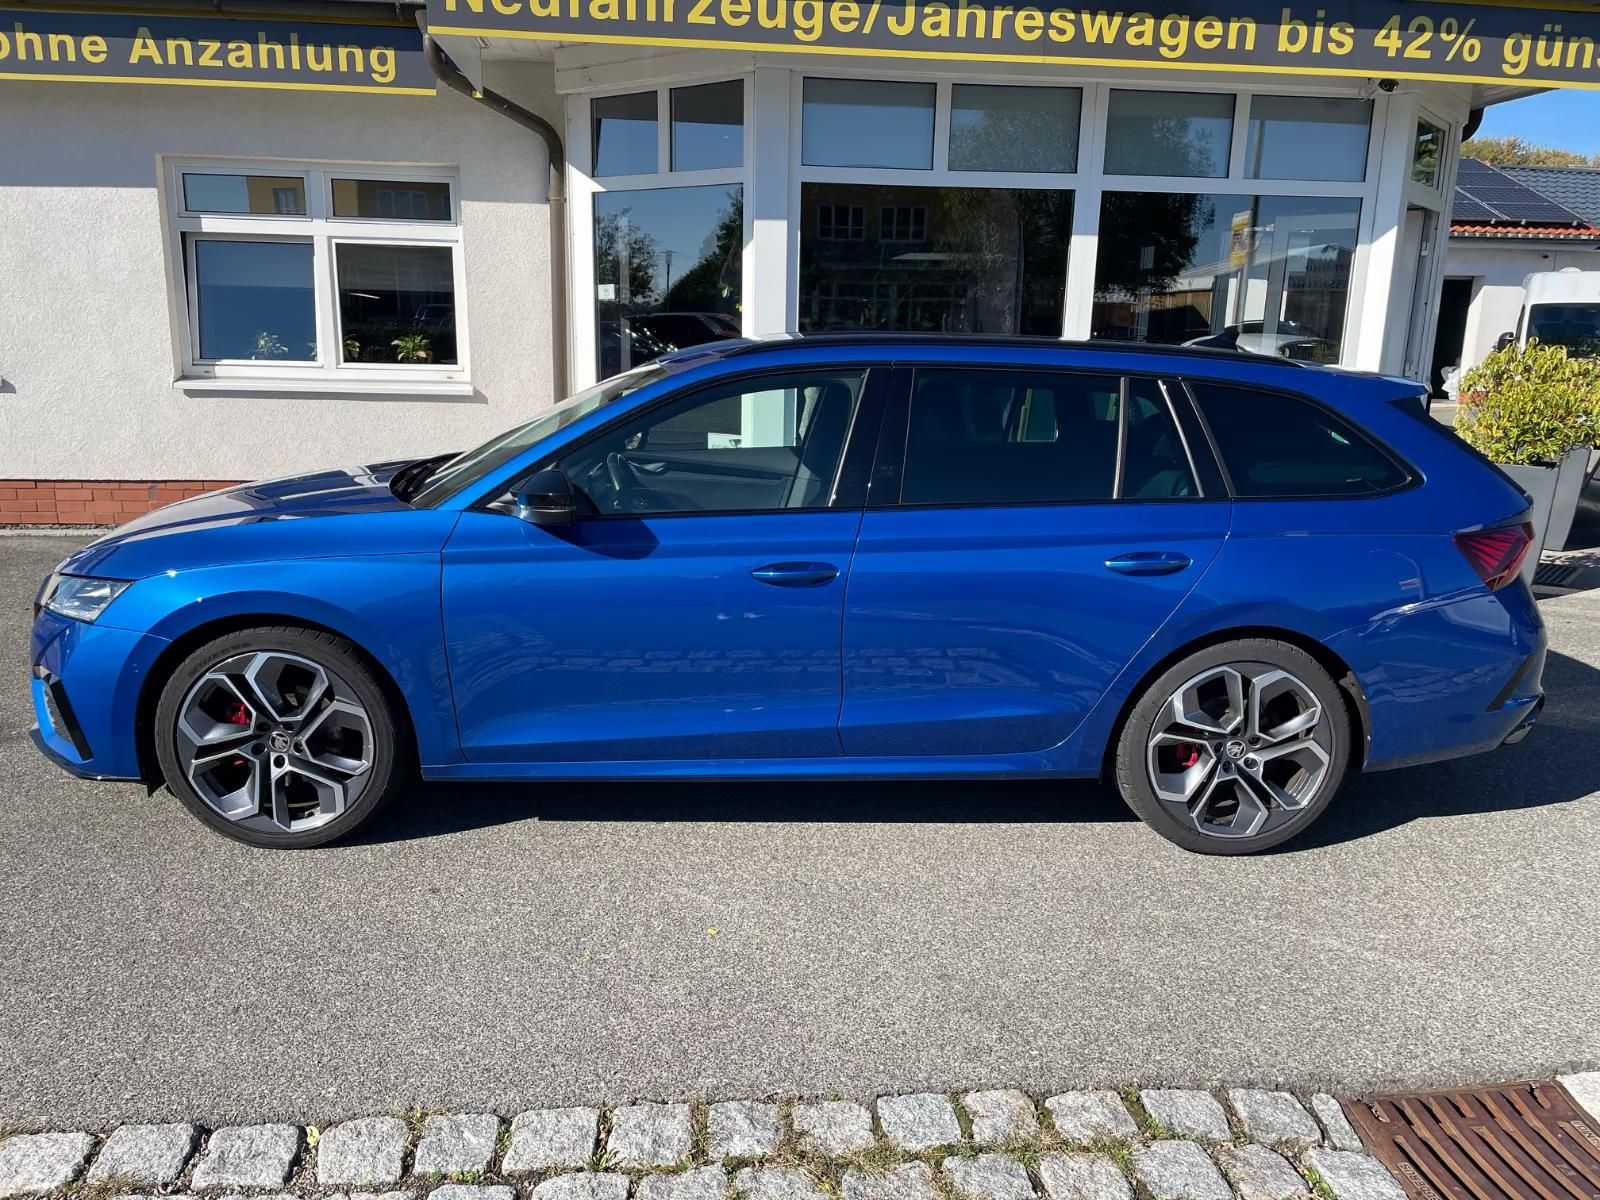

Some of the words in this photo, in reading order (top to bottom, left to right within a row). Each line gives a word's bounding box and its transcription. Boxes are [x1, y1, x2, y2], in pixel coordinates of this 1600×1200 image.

[129, 27, 396, 83] Anzahlung
[445, 0, 1257, 59] arzeuge/Jahreswagen
[1278, 8, 1355, 55] bis
[1374, 15, 1481, 62] 42%
[1502, 24, 1600, 75] gün
